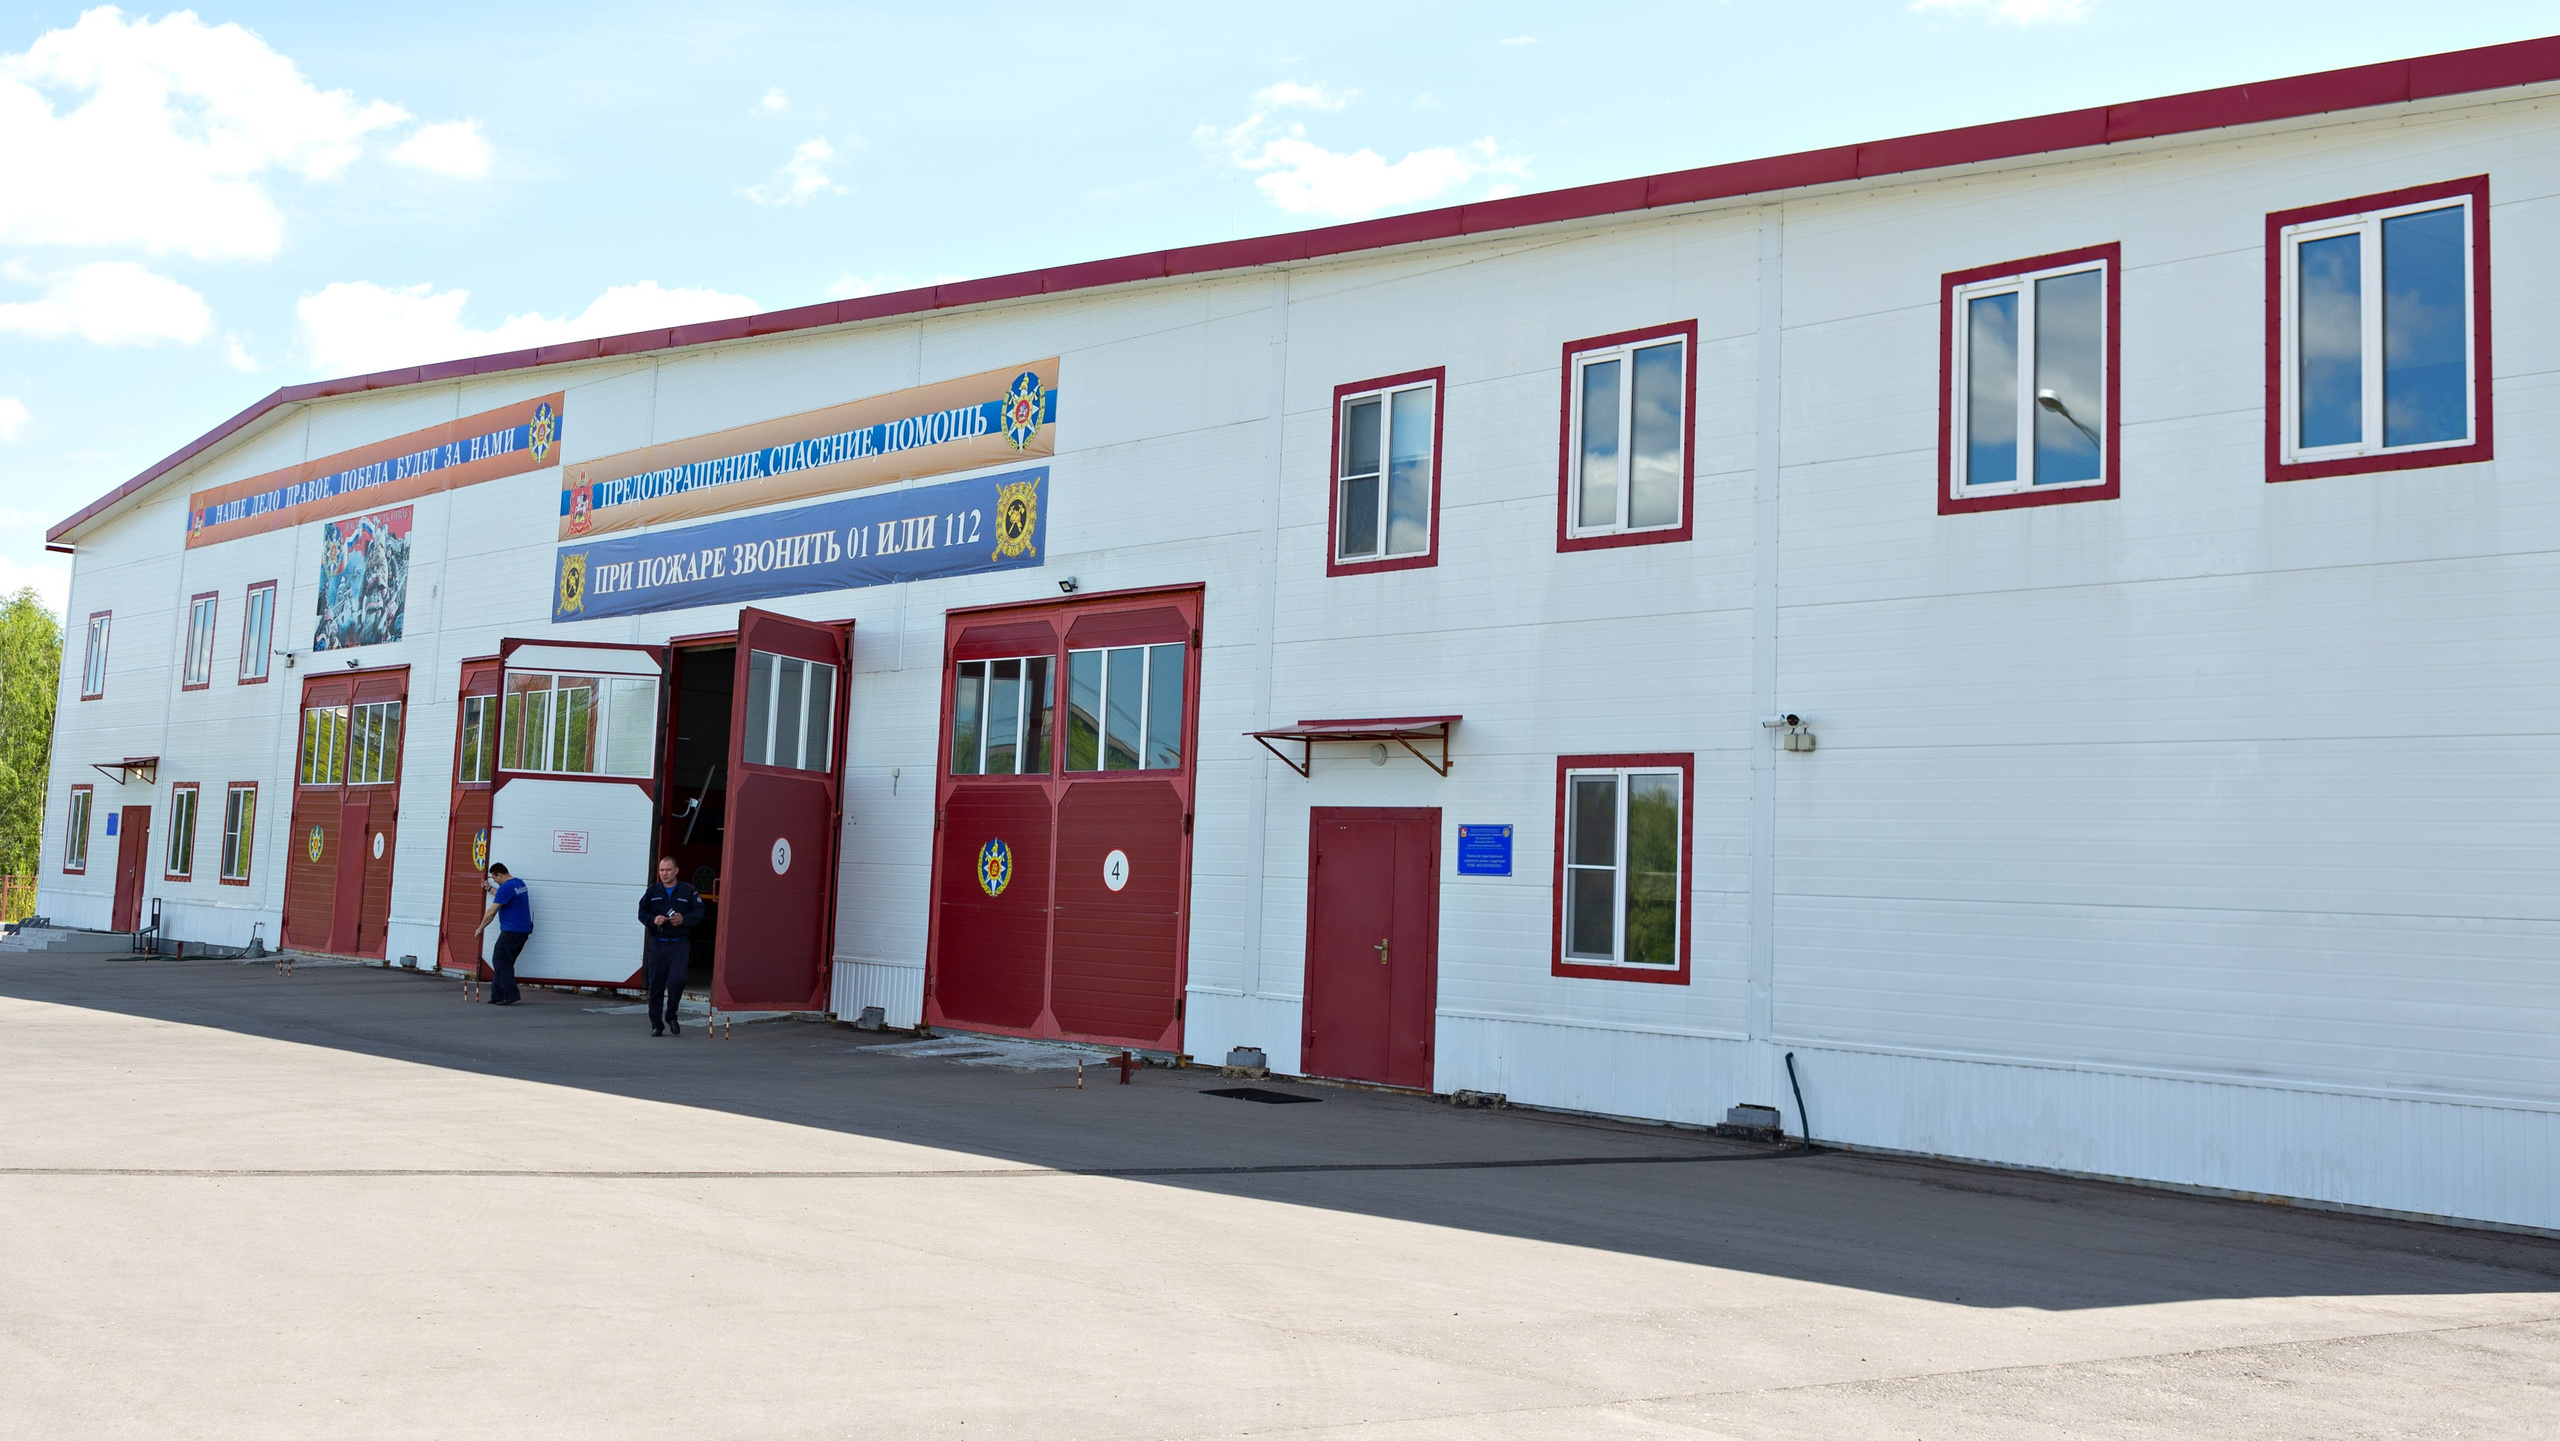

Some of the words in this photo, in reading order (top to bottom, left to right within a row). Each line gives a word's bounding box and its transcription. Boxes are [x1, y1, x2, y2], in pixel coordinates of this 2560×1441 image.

[215, 499, 247, 525] НАШЕ
[250, 490, 281, 519] ДЕЛО
[285, 476, 333, 507] ПРАВОЕ,
[339, 462, 389, 494] ПОБЕДА
[395, 449, 438, 480] БУДЕТ
[444, 443, 461, 468] ЗА
[469, 428, 516, 462] НАМИ
[601, 451, 765, 508] ПРЕДОТВРАЩЕНИЕ,
[768, 428, 878, 476] СПАСЕНИЕ,
[884, 403, 988, 452] ПОМОЩЬ
[593, 561, 633, 595] ПРИ
[636, 546, 727, 590] ПОЖАРЕ
[730, 530, 841, 576] ЗВОНИТЬ
[846, 525, 869, 560] 01
[875, 514, 938, 556] ИЛИ
[942, 508, 982, 547] 112
[778, 847, 785, 865] 3
[1111, 861, 1120, 880] 4
